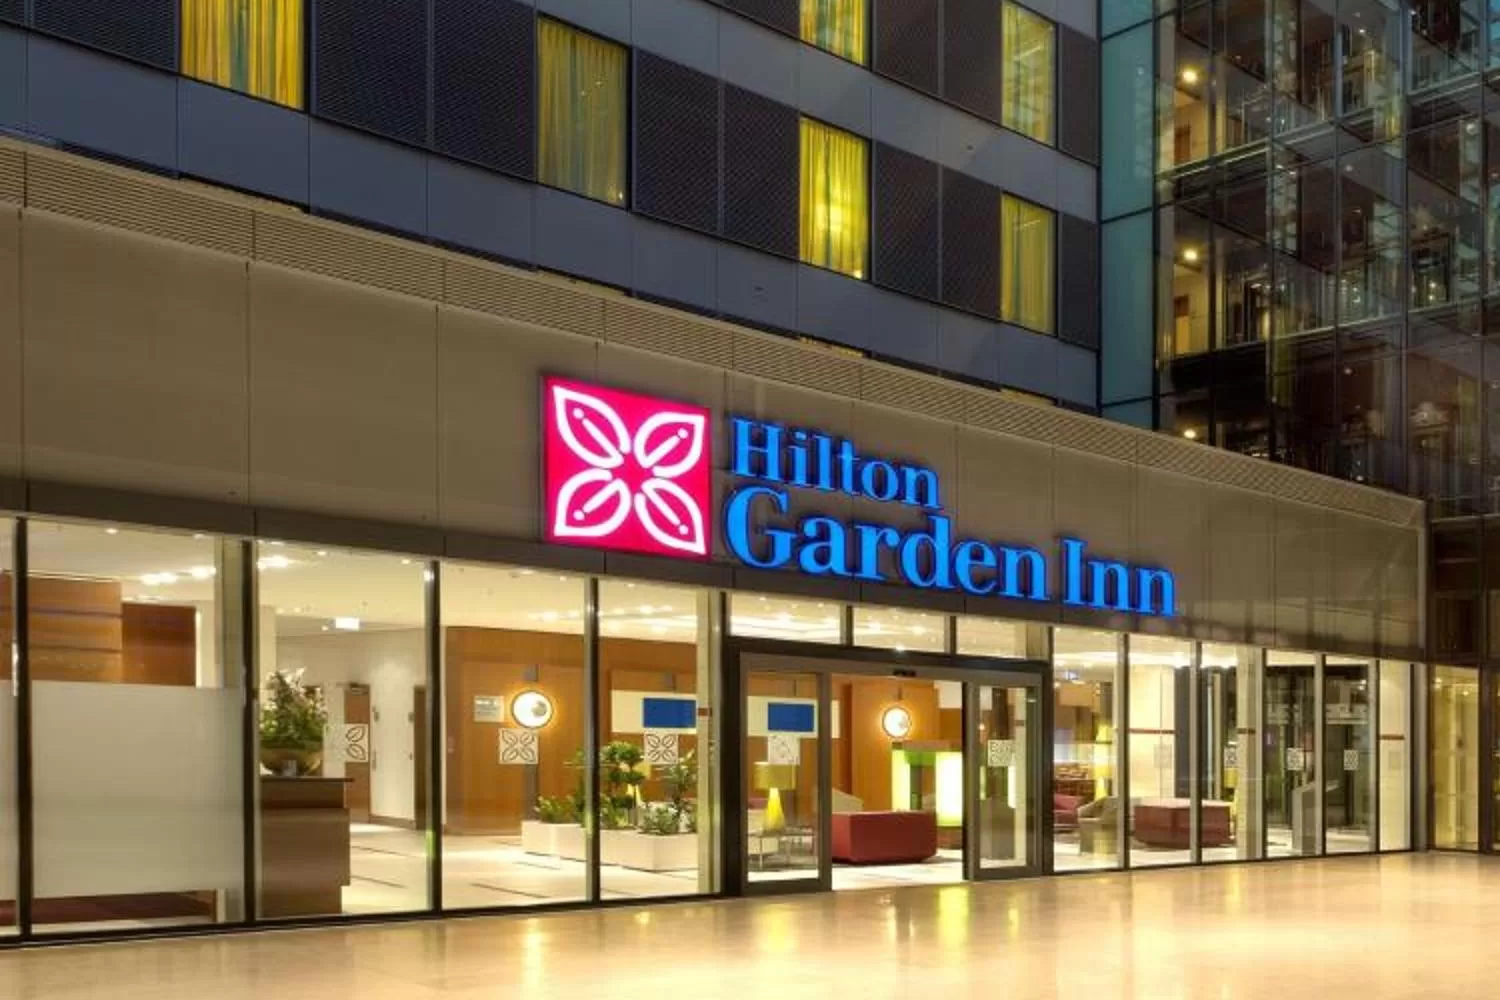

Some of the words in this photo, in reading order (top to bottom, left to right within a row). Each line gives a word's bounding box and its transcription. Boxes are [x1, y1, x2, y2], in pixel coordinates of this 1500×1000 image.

[732, 418, 940, 509] Hilton
[725, 487, 1048, 600] Garden
[1062, 538, 1176, 616] Inn
